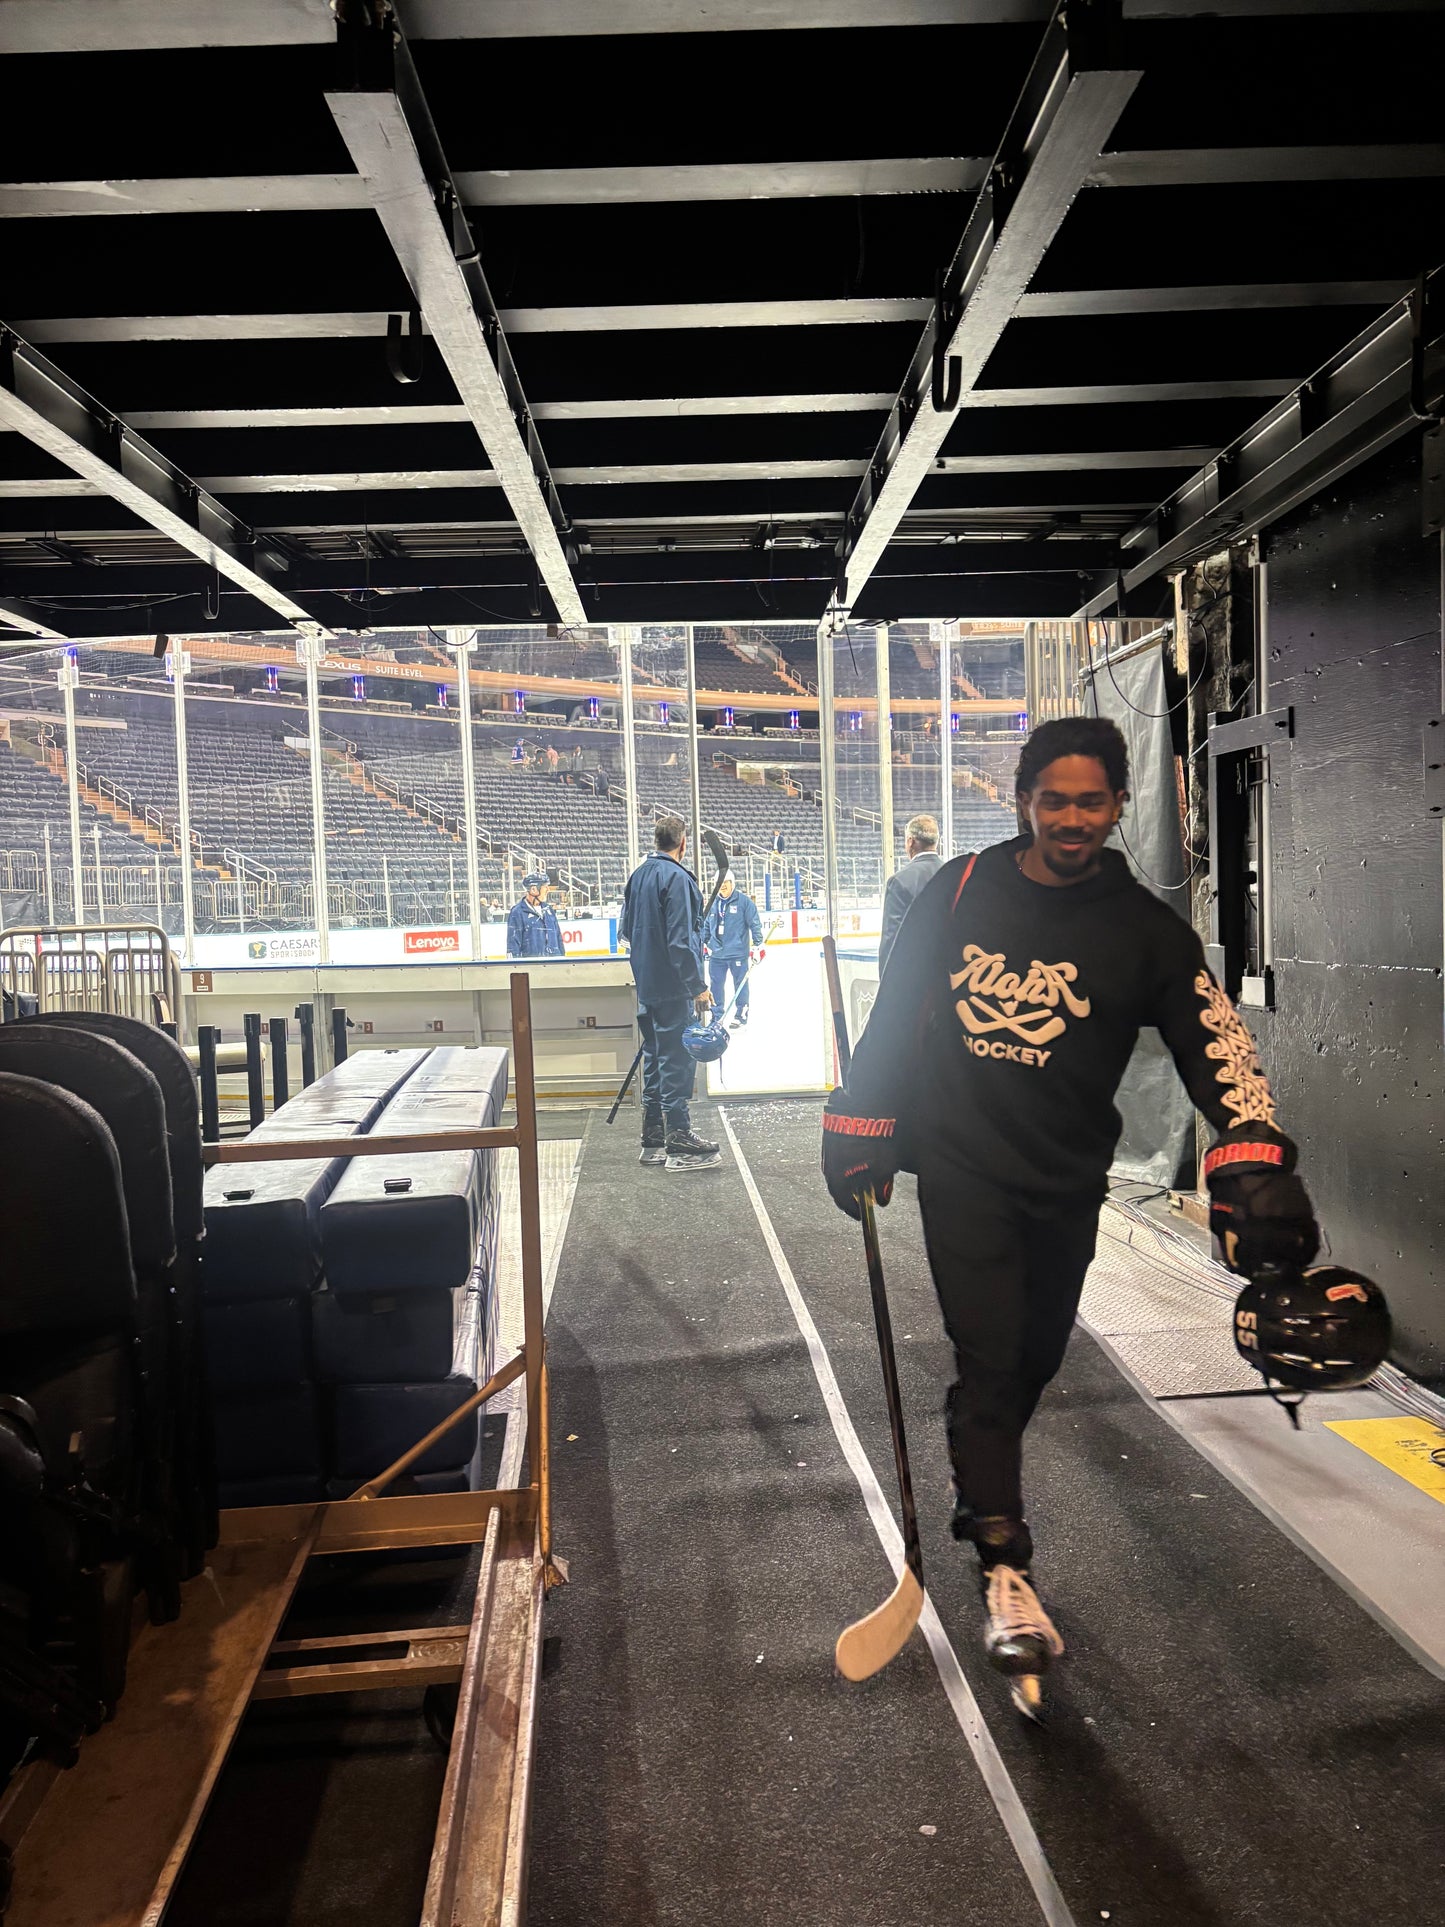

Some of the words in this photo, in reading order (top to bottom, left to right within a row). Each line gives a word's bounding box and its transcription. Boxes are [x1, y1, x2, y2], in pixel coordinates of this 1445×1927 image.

[317, 660, 361, 671] LEXUS
[375, 665, 399, 676] SUITE
[400, 668, 423, 678] LEVEL
[270, 938, 320, 950] CAESAR
[408, 935, 454, 949] Lenovo
[199, 973, 205, 984] 9
[962, 1034, 1051, 1068] HOCKEY
[1236, 1310, 1260, 1351] 55
